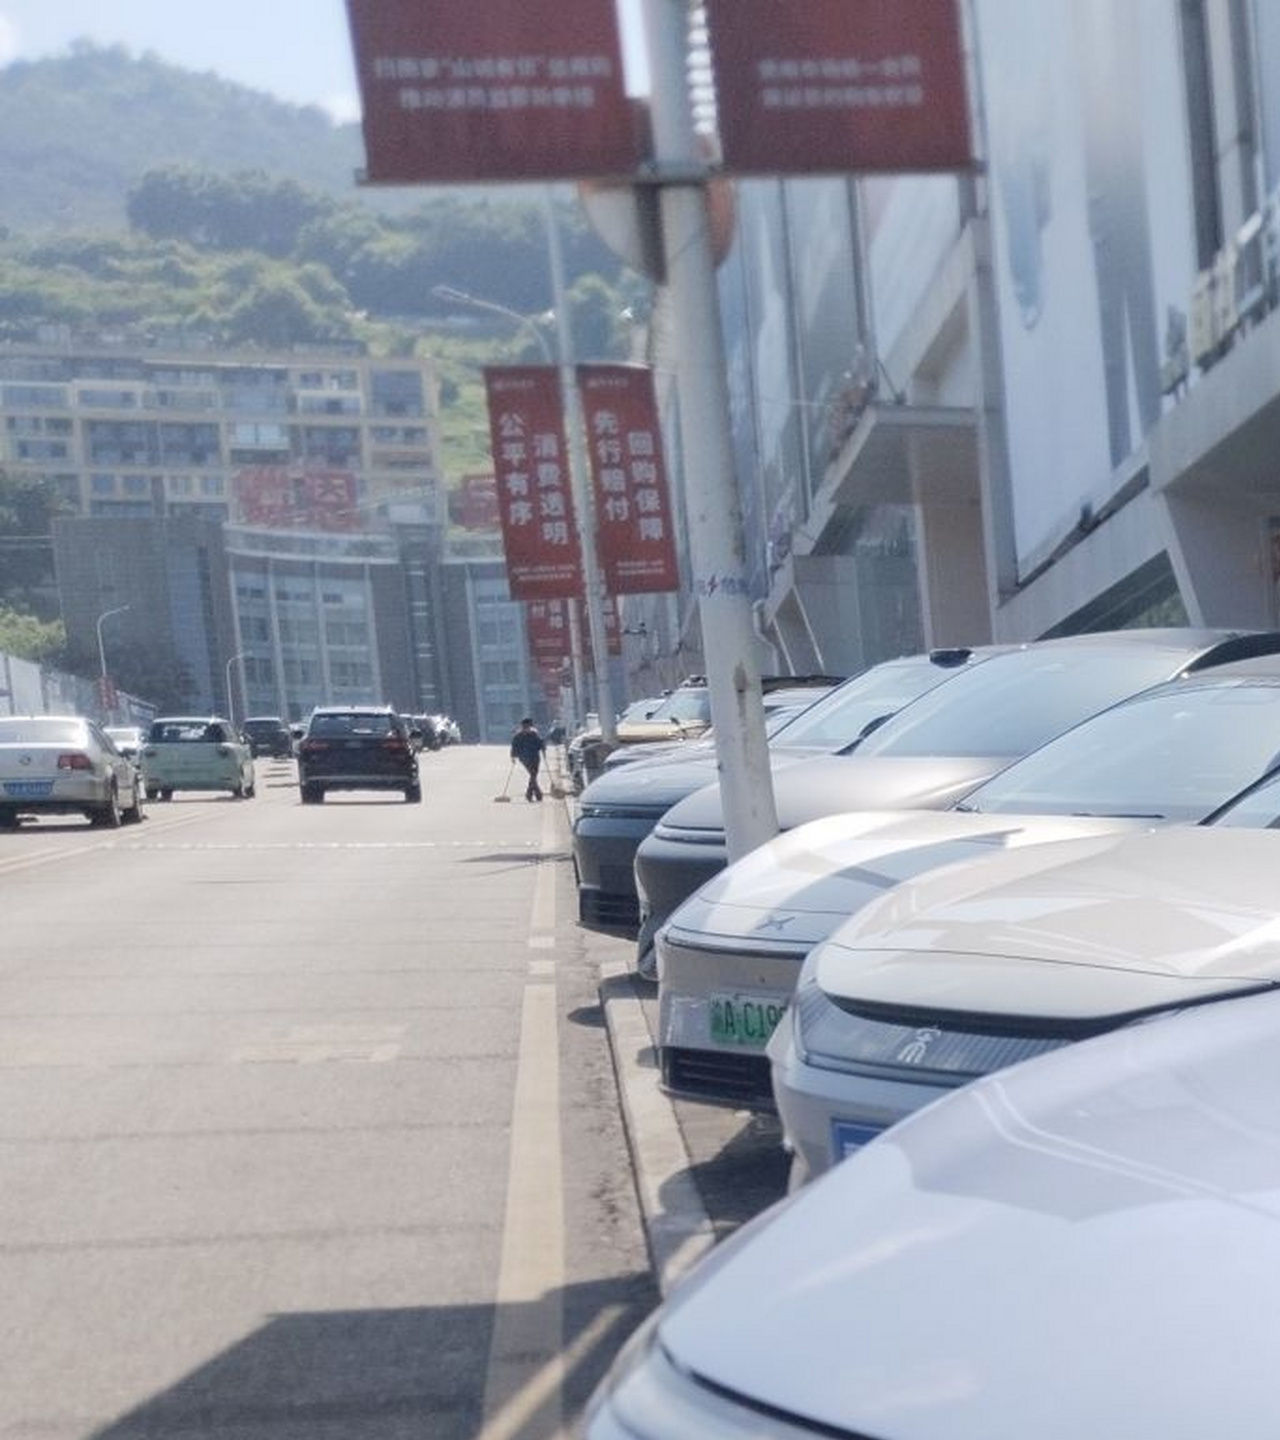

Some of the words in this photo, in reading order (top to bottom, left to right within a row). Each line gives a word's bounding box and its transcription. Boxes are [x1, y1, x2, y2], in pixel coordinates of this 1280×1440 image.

[500, 411, 534, 526] 公平有序
[533, 432, 569, 546] 消费透明
[594, 410, 630, 522] 先行赔付
